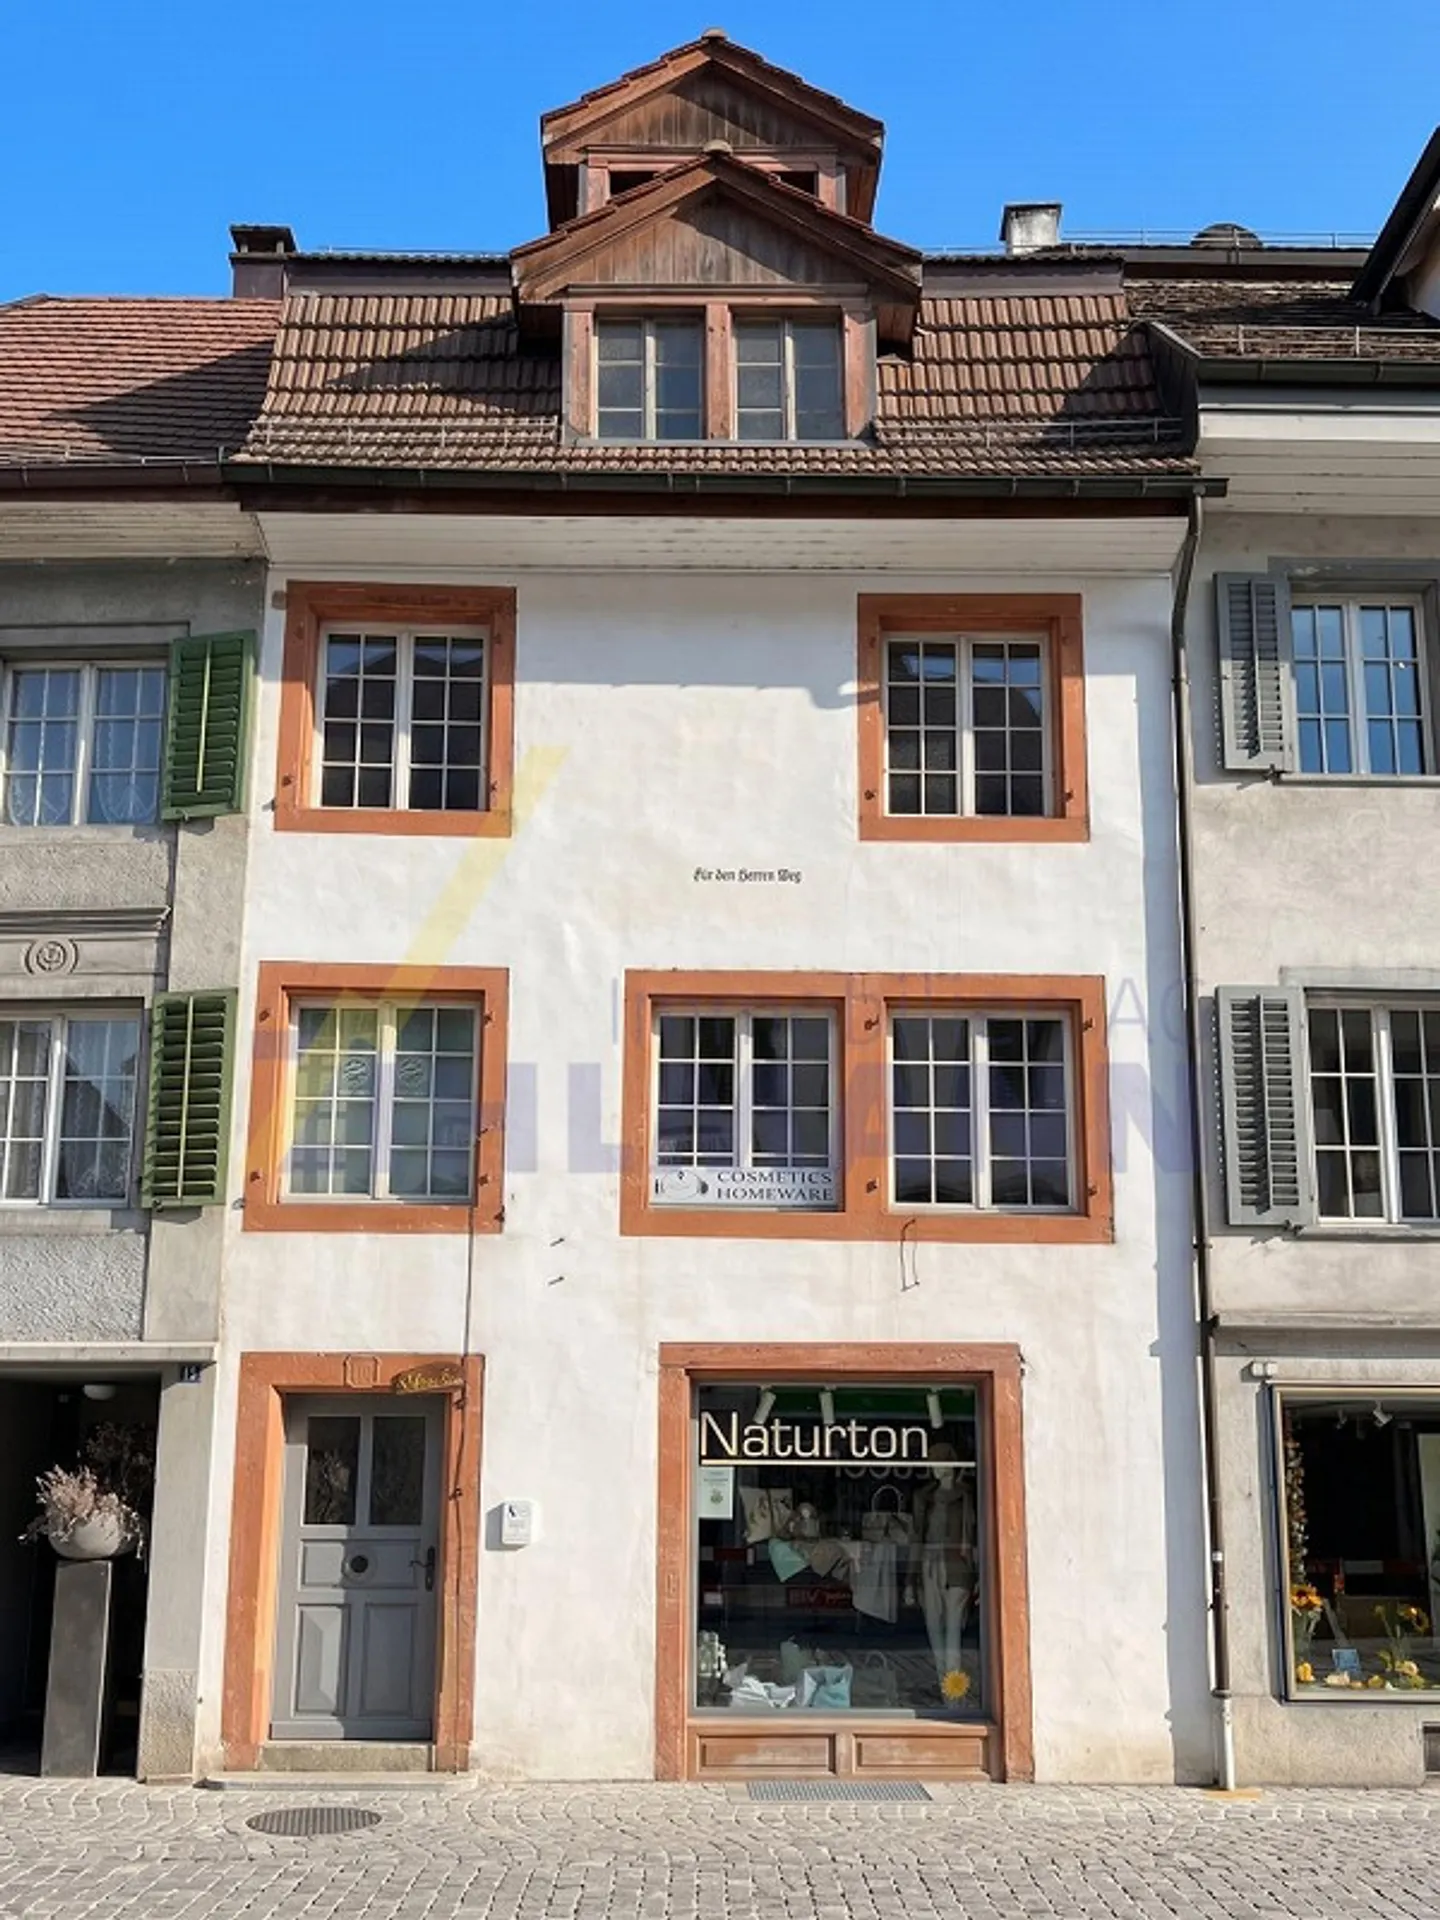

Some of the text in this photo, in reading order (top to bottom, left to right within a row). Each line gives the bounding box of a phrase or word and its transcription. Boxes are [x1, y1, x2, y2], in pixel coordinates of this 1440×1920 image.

[715, 868, 736, 881] den
[717, 1171, 833, 1184] COSMETICS
[717, 1187, 834, 1201] HOMEWARE
[700, 1411, 929, 1459] Naturton
